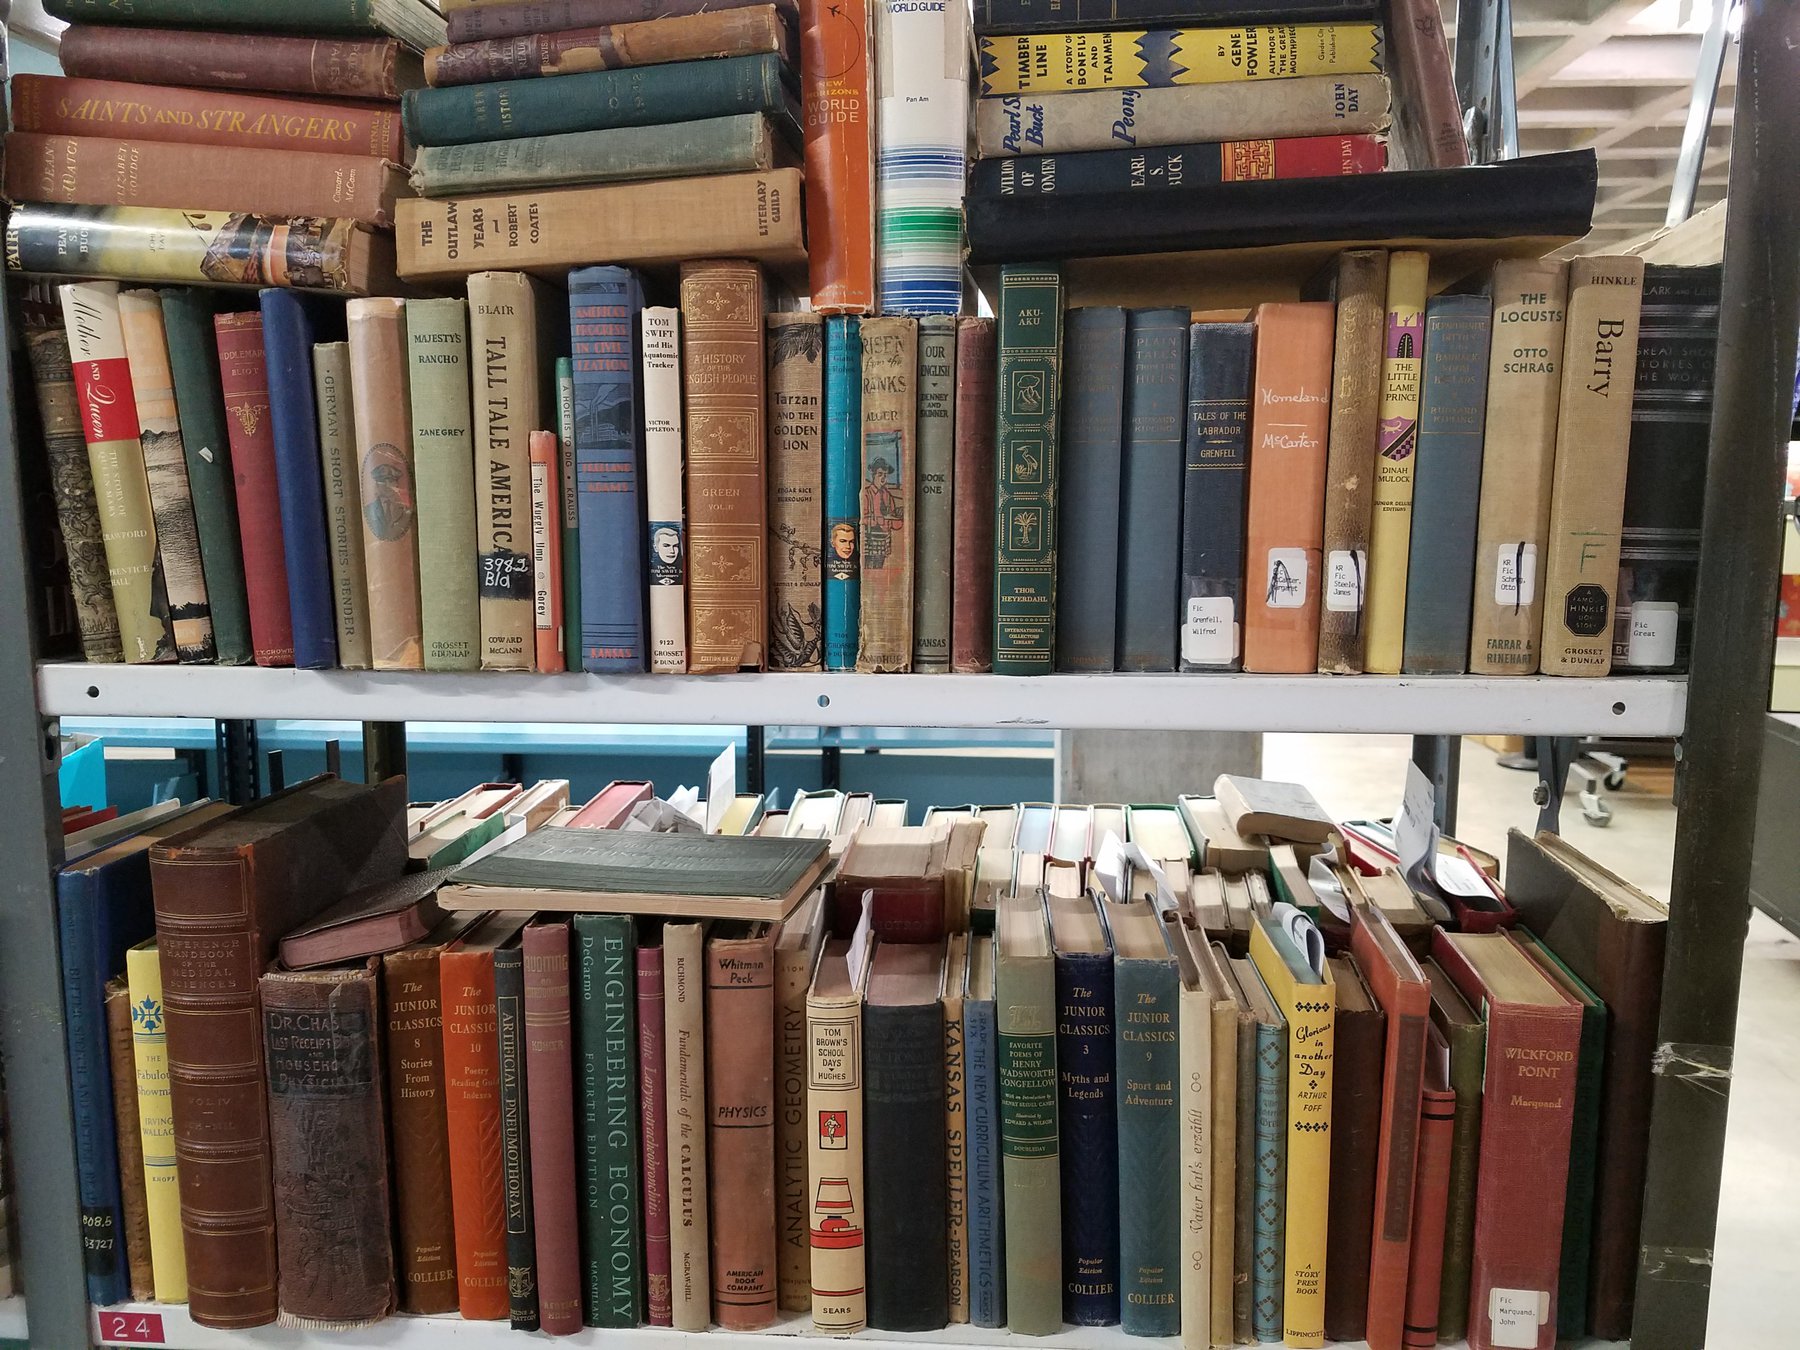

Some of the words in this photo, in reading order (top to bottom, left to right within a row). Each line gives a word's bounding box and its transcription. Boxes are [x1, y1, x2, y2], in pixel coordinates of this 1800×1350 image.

[1218, 45, 1225, 57] BY
[1231, 33, 1241, 66] GENE
[1247, 27, 1258, 76] FOWLER
[1018, 37, 1030, 89] TIMBER
[1036, 44, 1047, 77] LINE
[1065, 47, 1073, 74] STORY
[1078, 36, 1087, 85] BONFILS
[1090, 46, 1098, 68] AND
[1103, 33, 1113, 83] TAMMEN
[1268, 41, 1276, 74] AUTHOR
[808, 99, 860, 113] WORLD
[1335, 83, 1345, 119] JOHN
[1348, 88, 1359, 112] DAY
[56, 97, 151, 125] SAINTS
[154, 109, 193, 126] AND
[197, 109, 357, 142] STRANGERS
[809, 112, 860, 126] GUIDE
[1112, 90, 1141, 147] Peony
[1025, 104, 1043, 148] Buck
[1021, 171, 1035, 188] OF
[757, 180, 768, 236] LITERARY
[771, 188, 780, 224] GUILD
[473, 207, 485, 249] YEARS
[508, 203, 519, 247] ROBERT
[529, 202, 540, 244] COATES
[421, 220, 433, 247] THE
[448, 201, 459, 259] OUTLAW
[1591, 276, 1637, 286] HINKLE
[1520, 293, 1547, 305] THE
[478, 304, 515, 315] BLAIR
[1018, 309, 1043, 317] AKU-
[648, 318, 670, 326] TOM
[1018, 317, 1040, 326] AKU
[1500, 310, 1563, 323] LOCUSTS
[413, 333, 462, 344] MAJESTY'S
[645, 330, 675, 339] SWIFT
[925, 346, 945, 358] OUR
[1513, 348, 1548, 358] OTTO
[1587, 318, 1625, 398] Barry
[418, 354, 459, 364] RANCHO
[485, 336, 507, 389] TALL
[703, 354, 746, 364] HISTORY
[647, 361, 674, 370] Tracker
[920, 365, 950, 377] ENGLISH
[1395, 363, 1413, 372] THE
[1503, 362, 1554, 374] SCHRAG
[1387, 373, 1418, 381] LITTLE
[1389, 383, 1415, 392] LAME
[774, 393, 818, 405] Tarzan
[921, 393, 948, 401] DENNEY
[1261, 387, 1329, 406] Homeland
[1386, 393, 1417, 402] PRINCE
[324, 375, 339, 437] GERMAN
[563, 395, 571, 418] HOLE
[1193, 411, 1216, 421] TALES
[488, 397, 510, 450] TALE
[774, 425, 818, 436] GOLDEN
[1197, 426, 1241, 435] LABRADOR
[783, 440, 809, 450] LION
[1261, 432, 1319, 449] McCarter
[565, 451, 573, 468] DIG
[1200, 449, 1236, 458] GRENFELL
[330, 447, 344, 498] SHORT
[1382, 467, 1408, 475] DINAH
[921, 474, 945, 482] BOOK
[533, 477, 543, 494] The
[923, 486, 942, 494] ONE
[702, 488, 740, 497] GREEN
[490, 460, 513, 553] AMERICA
[567, 487, 576, 521] KRAUSS
[334, 505, 349, 567] STORIES
[537, 590, 548, 617] Gorey
[1634, 621, 1648, 629] Fic
[488, 636, 523, 644] COWARD
[1633, 630, 1656, 638] Great
[431, 641, 469, 649] GROSSET
[917, 638, 946, 648] KANSAS
[1487, 639, 1522, 650] FARRAR
[653, 650, 684, 658] GROSSET
[1564, 647, 1604, 655] GROSSET
[1487, 653, 1532, 665] RINEHART
[582, 936, 594, 1001] DeGarmo
[718, 958, 764, 969] Whitman
[677, 957, 685, 1003] RICHMOND
[730, 972, 754, 983] Peck
[402, 982, 423, 993] The
[1072, 987, 1093, 998] The
[1137, 993, 1157, 1004] The
[393, 999, 438, 1012] JUNIOR
[454, 1004, 497, 1016] JUNIOR
[1063, 1006, 1106, 1017] JUNIOR
[389, 1016, 443, 1031] CLASSICS
[1127, 1012, 1170, 1024] JUNIOR
[823, 1028, 841, 1036] TOM
[1059, 1024, 1110, 1035] CLASSICS
[1295, 1023, 1331, 1044] Glorious
[816, 1038, 848, 1046] BROWN'S
[1122, 1030, 1176, 1042] CLASSICS
[604, 936, 628, 1149] ENGINEERING
[502, 1012, 516, 1092] ARTIFICIAL
[818, 1049, 845, 1057] SCHOOL
[1083, 1044, 1090, 1055] 3
[1504, 1048, 1574, 1062] WICKFORD
[1294, 1051, 1333, 1061] another
[401, 1058, 433, 1069] Stories
[784, 1006, 801, 1125] GEOMETRY
[822, 1059, 842, 1067] DAYS
[945, 1019, 962, 1113] KANSAS
[1012, 1060, 1041, 1068] HENRY
[818, 1072, 846, 1080] HUGHES
[1000, 1068, 1055, 1077] WADSWORTH
[1298, 1062, 1326, 1079] Day
[1518, 1065, 1561, 1079] POINT
[405, 1074, 430, 1084] From
[1000, 1077, 1056, 1087] LONGFELLOW
[1093, 1073, 1110, 1083] and
[585, 1053, 596, 1122] FOURTH
[1155, 1080, 1172, 1090] and
[401, 1087, 436, 1099] History
[1068, 1087, 1104, 1100] Legends
[1297, 1091, 1327, 1099] ARTHUR
[1125, 1094, 1174, 1106] Adventure
[1510, 1095, 1562, 1109] Marquand
[718, 1105, 767, 1118] PHYSICS
[1303, 1104, 1323, 1112] FOFF
[974, 1107, 990, 1191] CURRICULUM
[504, 1099, 521, 1219] PNEUMOTHORAX
[586, 1134, 598, 1208] EDITION
[680, 1143, 693, 1227] CALCULUS
[785, 1140, 803, 1248] ANALYTIC
[608, 1164, 632, 1320] ECONOMY
[726, 1269, 764, 1277] AMERICAN
[1294, 1270, 1321, 1278] STORY
[591, 1260, 599, 1320] MACMILLAN
[727, 1284, 764, 1292] COMPANY
[1068, 1283, 1114, 1295] COLLIER
[1296, 1287, 1318, 1295] BOOK
[1127, 1293, 1176, 1305] COLLIER
